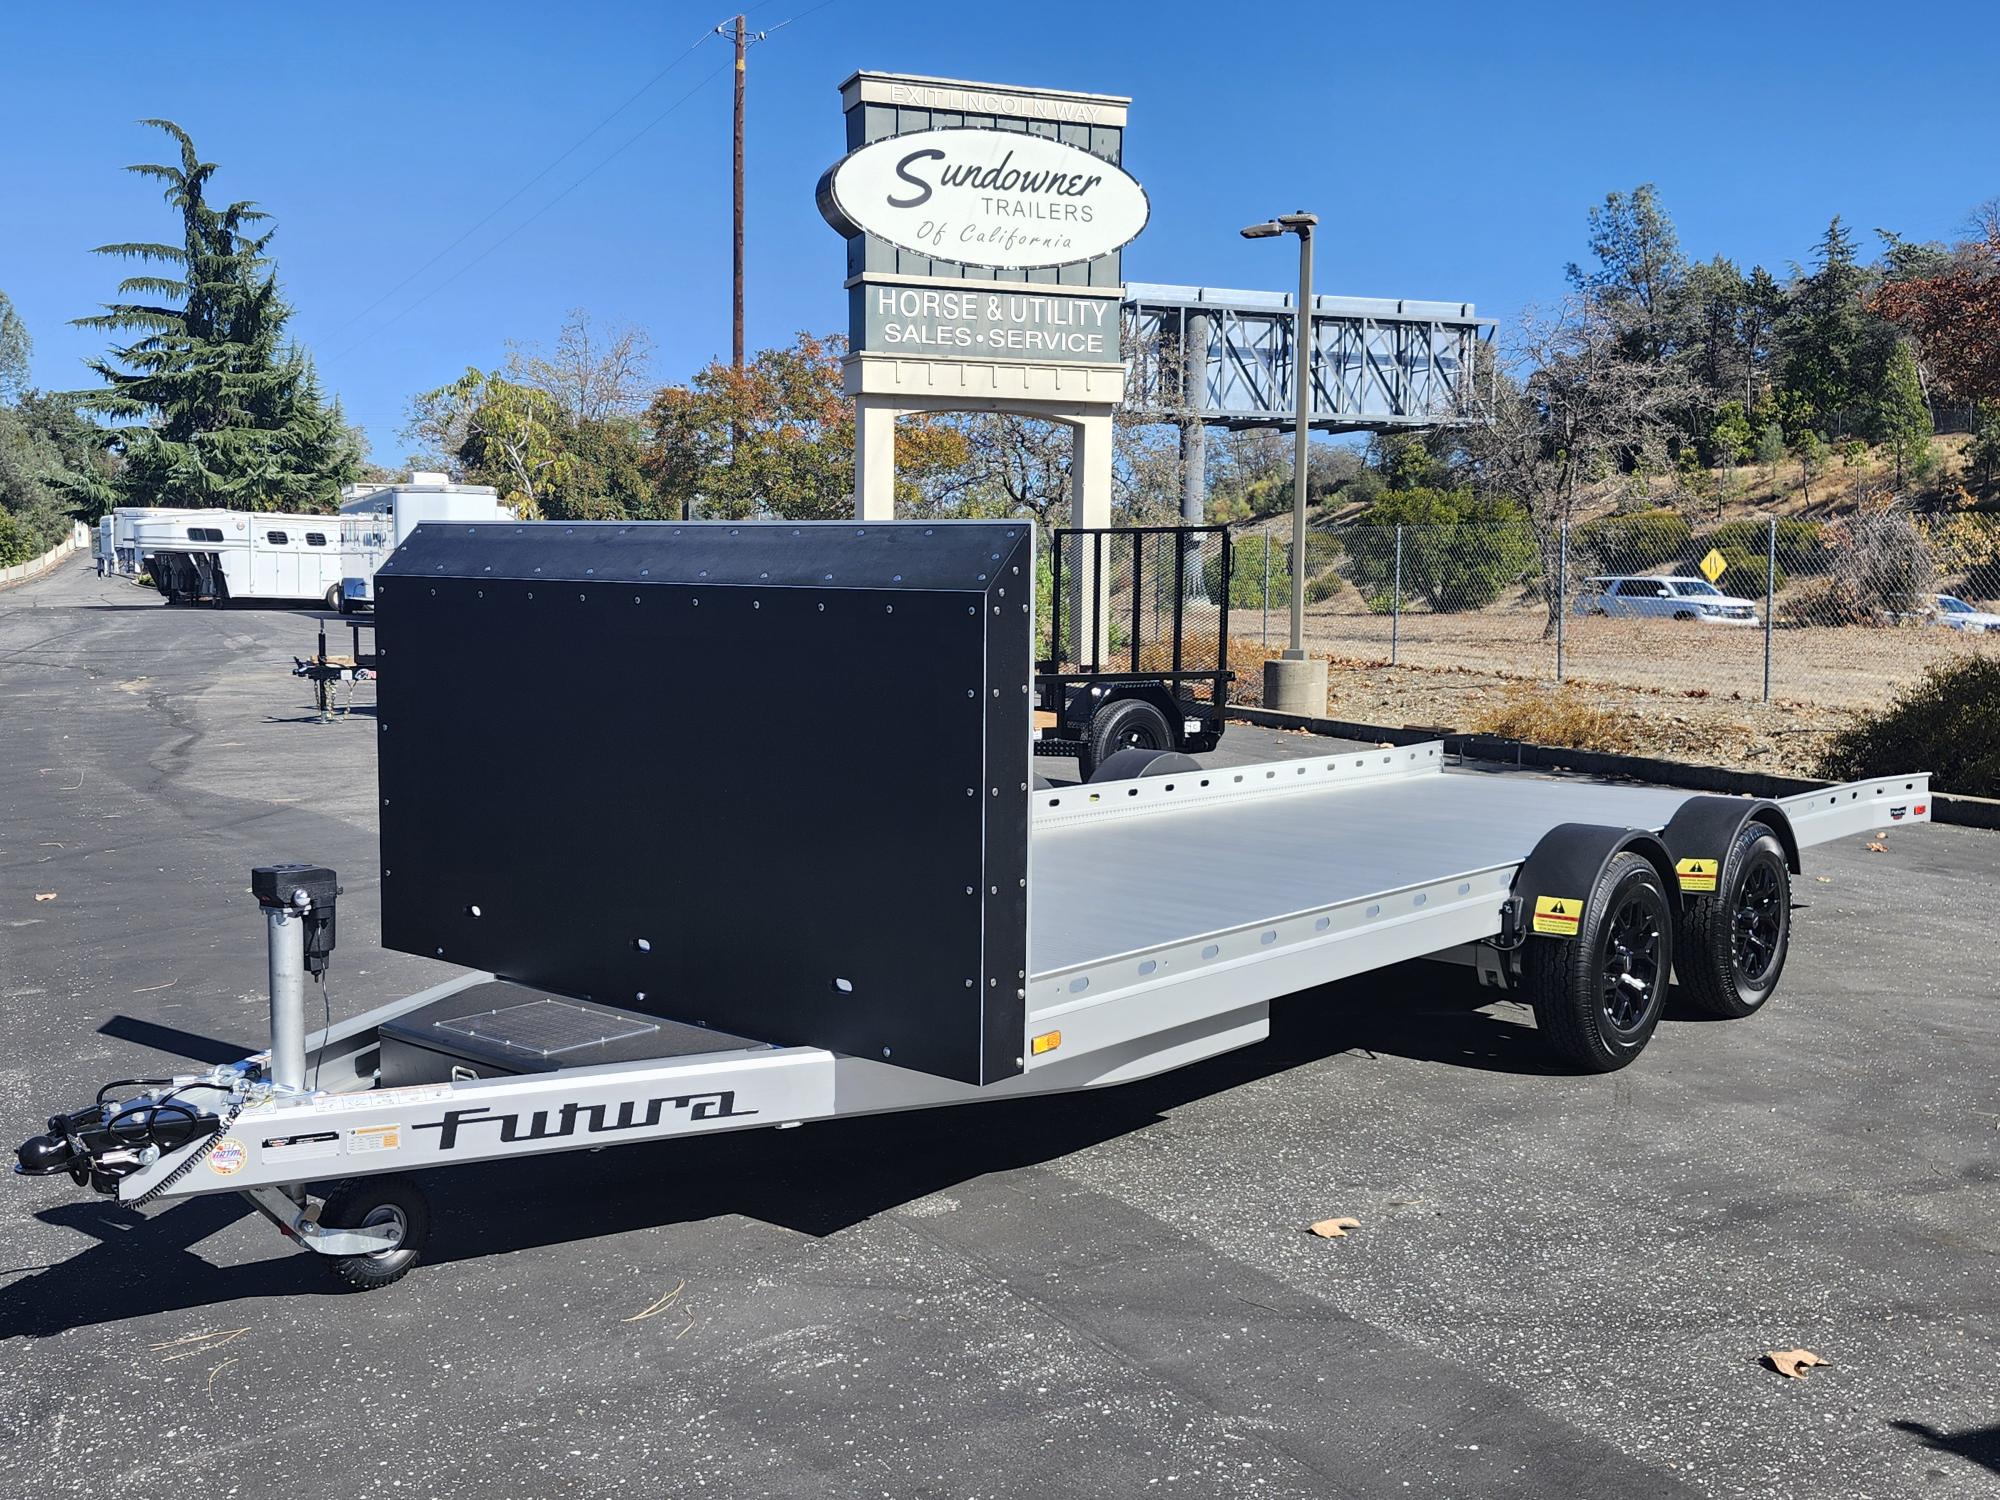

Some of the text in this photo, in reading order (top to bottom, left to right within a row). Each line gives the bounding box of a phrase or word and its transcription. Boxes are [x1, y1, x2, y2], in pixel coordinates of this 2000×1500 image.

[890, 84, 1100, 122] EXIT LINCOLN WAY
[886, 148, 1102, 209] Sundowner
[981, 197, 1093, 223] TRAILERS
[916, 220, 1071, 251] Of California
[878, 288, 1108, 328] HORSE & UTILITY
